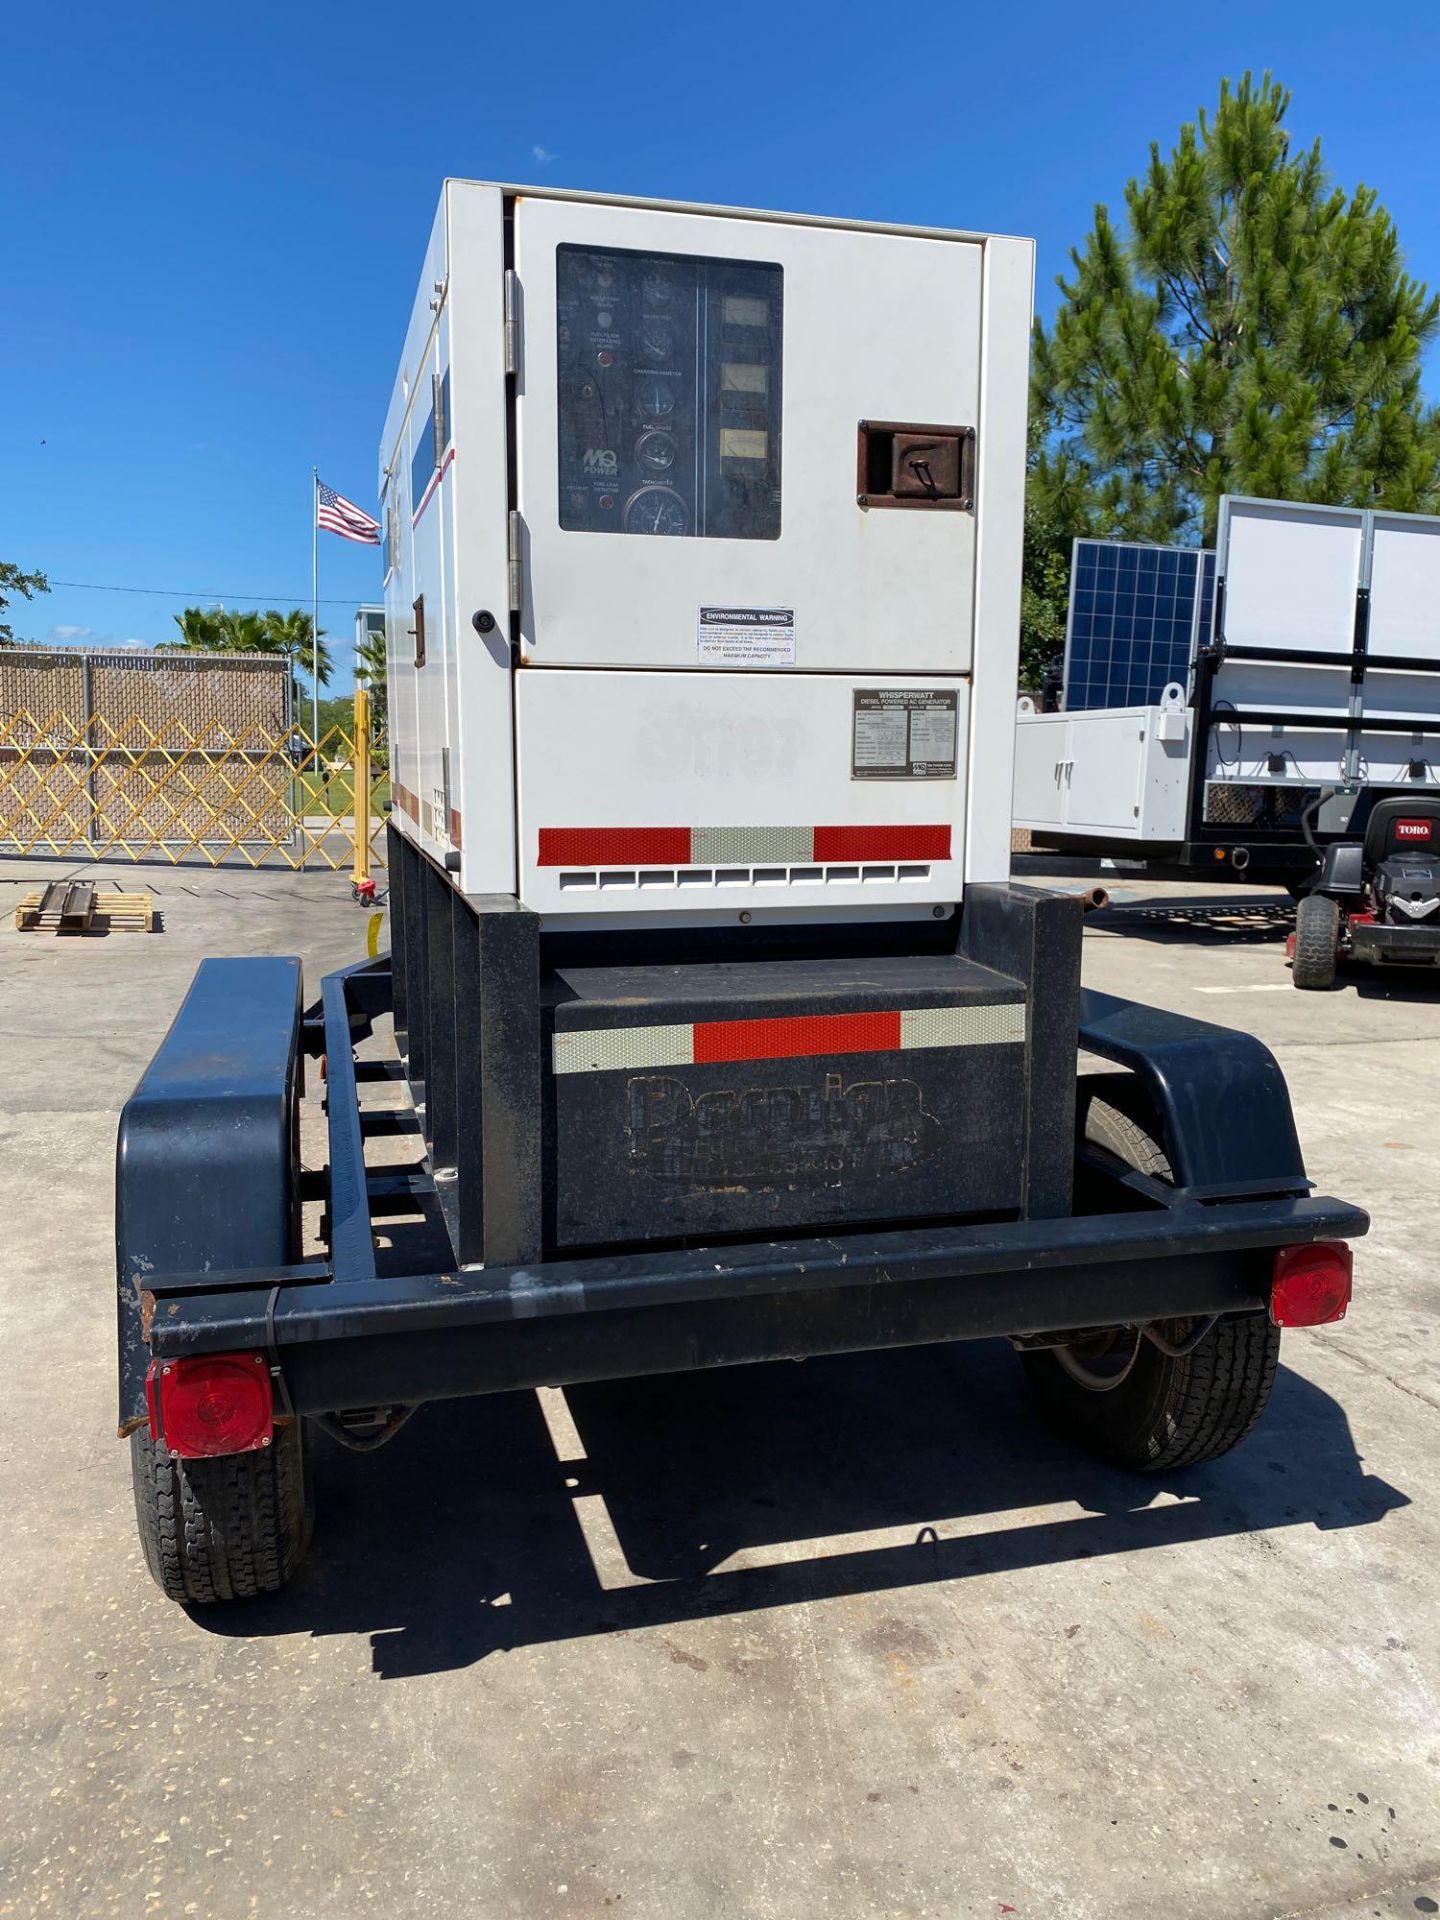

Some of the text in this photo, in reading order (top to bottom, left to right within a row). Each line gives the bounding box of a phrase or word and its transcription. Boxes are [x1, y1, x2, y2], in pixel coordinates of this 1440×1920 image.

[583, 449, 618, 468] MQ
[584, 466, 618, 475] POWER
[706, 613, 788, 622] ENVIRONMENTAL WARNING
[1399, 825, 1429, 835] TORO
